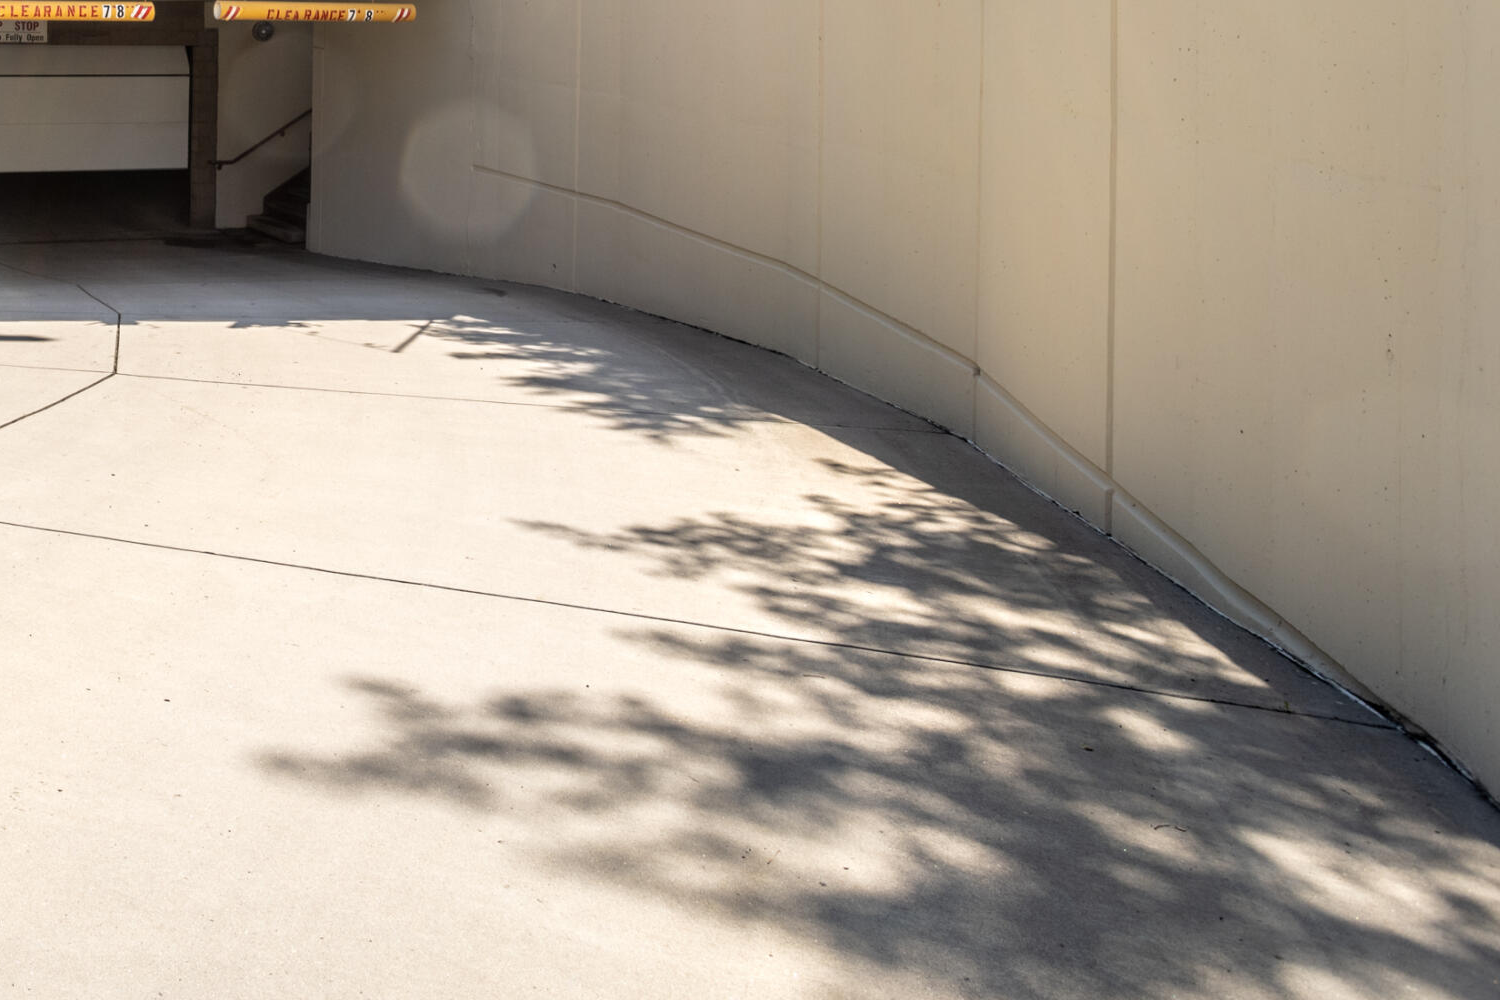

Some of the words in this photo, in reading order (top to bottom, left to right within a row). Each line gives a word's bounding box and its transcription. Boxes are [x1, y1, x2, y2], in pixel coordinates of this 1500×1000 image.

[14, 21, 39, 31] STOP
[5, 33, 23, 42] Fully
[26, 34, 44, 42] Open
